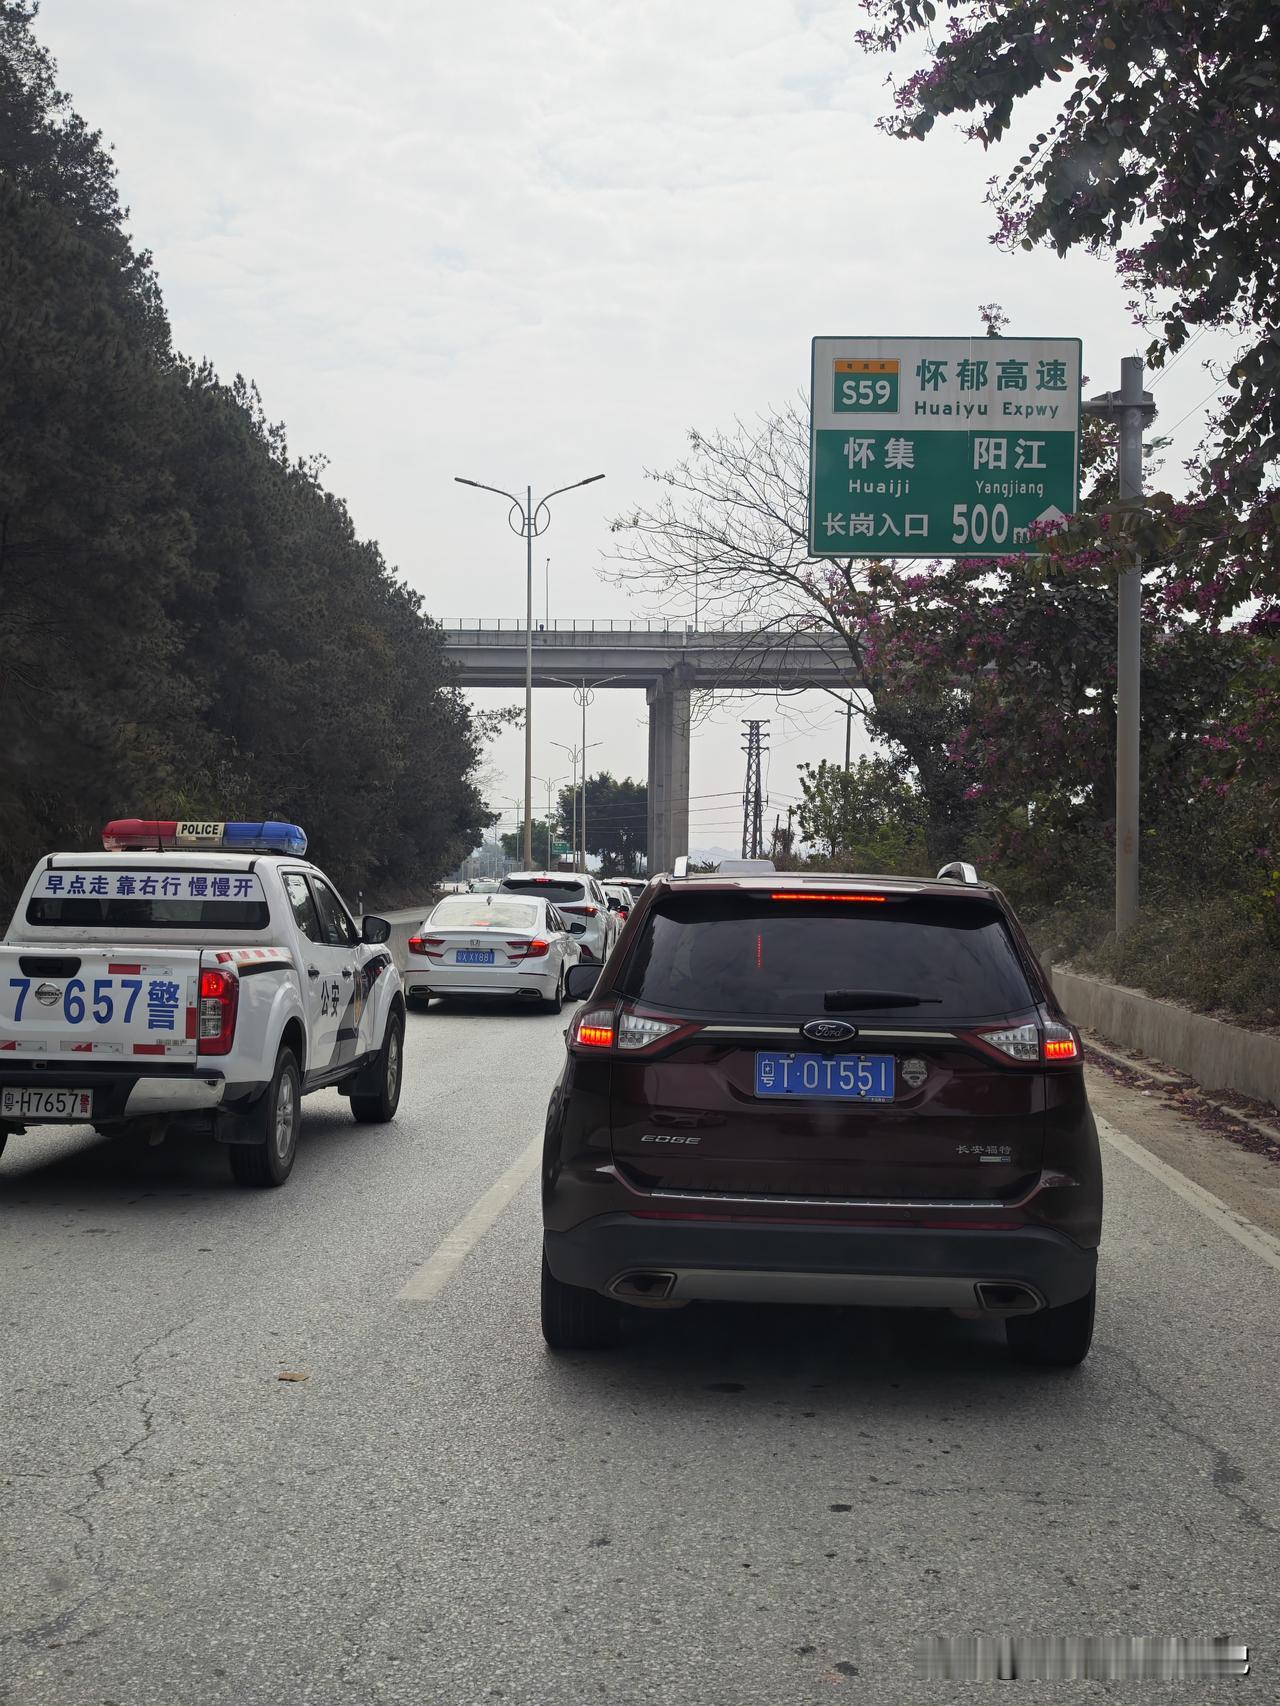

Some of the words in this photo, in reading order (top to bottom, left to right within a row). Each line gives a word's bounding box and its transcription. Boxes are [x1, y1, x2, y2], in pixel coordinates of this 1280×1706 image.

[915, 358, 1068, 392] 怀郁高速
[841, 380, 891, 405] S59
[914, 401, 988, 419] Huaiyu
[1002, 402, 1059, 419] Expwy
[843, 436, 915, 470] 怀集
[973, 437, 1047, 471] 阳江
[848, 480, 911, 498] Huaiji
[976, 480, 1044, 498] Yangjiang
[822, 512, 929, 537] 长岗入口
[181, 824, 219, 835] POLICE
[45, 875, 109, 896] 早点走
[117, 876, 182, 897] 靠右行
[189, 877, 254, 899] 慢慢开
[321, 980, 339, 1018] 公安
[815, 1024, 844, 1037] Ford
[641, 1134, 702, 1145] EDGE
[956, 1144, 1012, 1155] 长安福特
